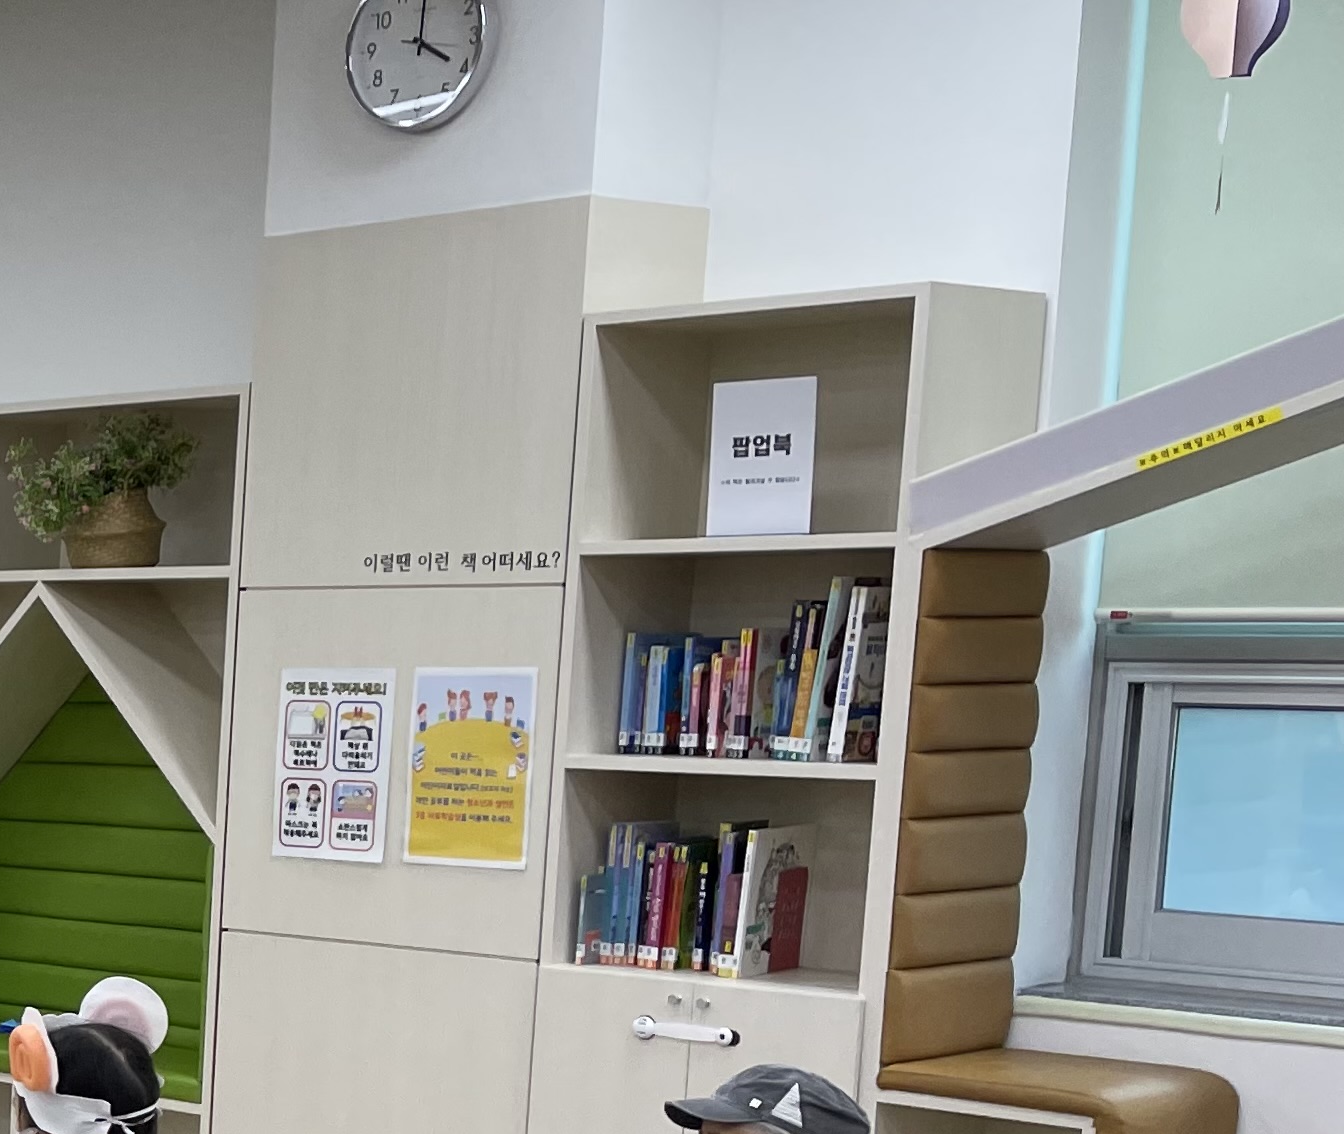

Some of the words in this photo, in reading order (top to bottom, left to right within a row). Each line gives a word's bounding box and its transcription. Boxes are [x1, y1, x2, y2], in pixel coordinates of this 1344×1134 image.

[375, 11, 392, 30] 10
[469, 25, 479, 45] 3
[367, 42, 377, 60] 9
[459, 58, 469, 73] 4
[372, 69, 383, 87] 8
[390, 89, 399, 105] 7
[732, 433, 792, 458] 팝업북
[363, 552, 411, 573] 이럴땐
[418, 551, 449, 572] 이런
[461, 552, 477, 573] 책
